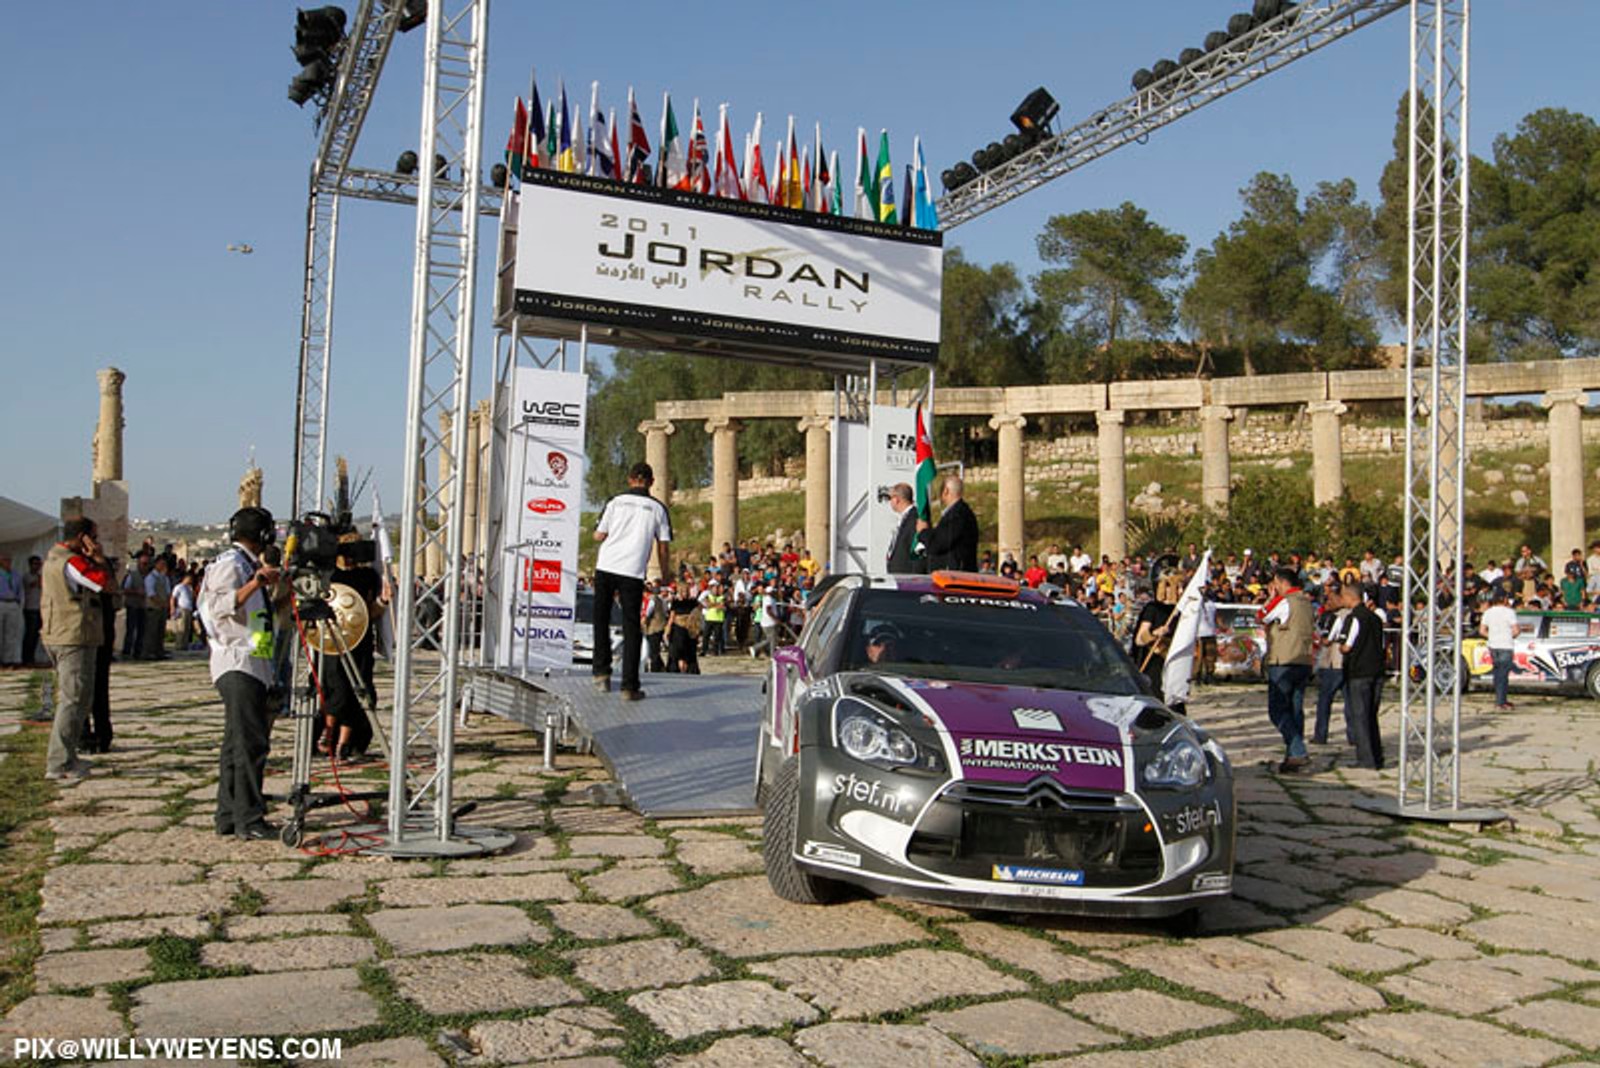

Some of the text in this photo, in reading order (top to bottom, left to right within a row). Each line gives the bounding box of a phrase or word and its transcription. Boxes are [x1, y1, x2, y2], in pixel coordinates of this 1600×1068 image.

[557, 177, 626, 194] JORDAN
[705, 200, 770, 216] JORDAN
[600, 213, 697, 240] 2011
[844, 222, 902, 237] JORDAN
[598, 233, 870, 293] JORDAN
[652, 270, 687, 289] رالي
[551, 299, 620, 315] JORDAN
[743, 284, 869, 314] RALLY
[702, 318, 766, 333] JORDAN
[841, 337, 900, 350] JORDAN
[522, 400, 580, 418] WRC
[514, 628, 567, 640] NOKIA
[962, 758, 1060, 772] INTERNATIONAL
[832, 773, 901, 813] stef.nl
[1014, 868, 1079, 881] MICHELIN
